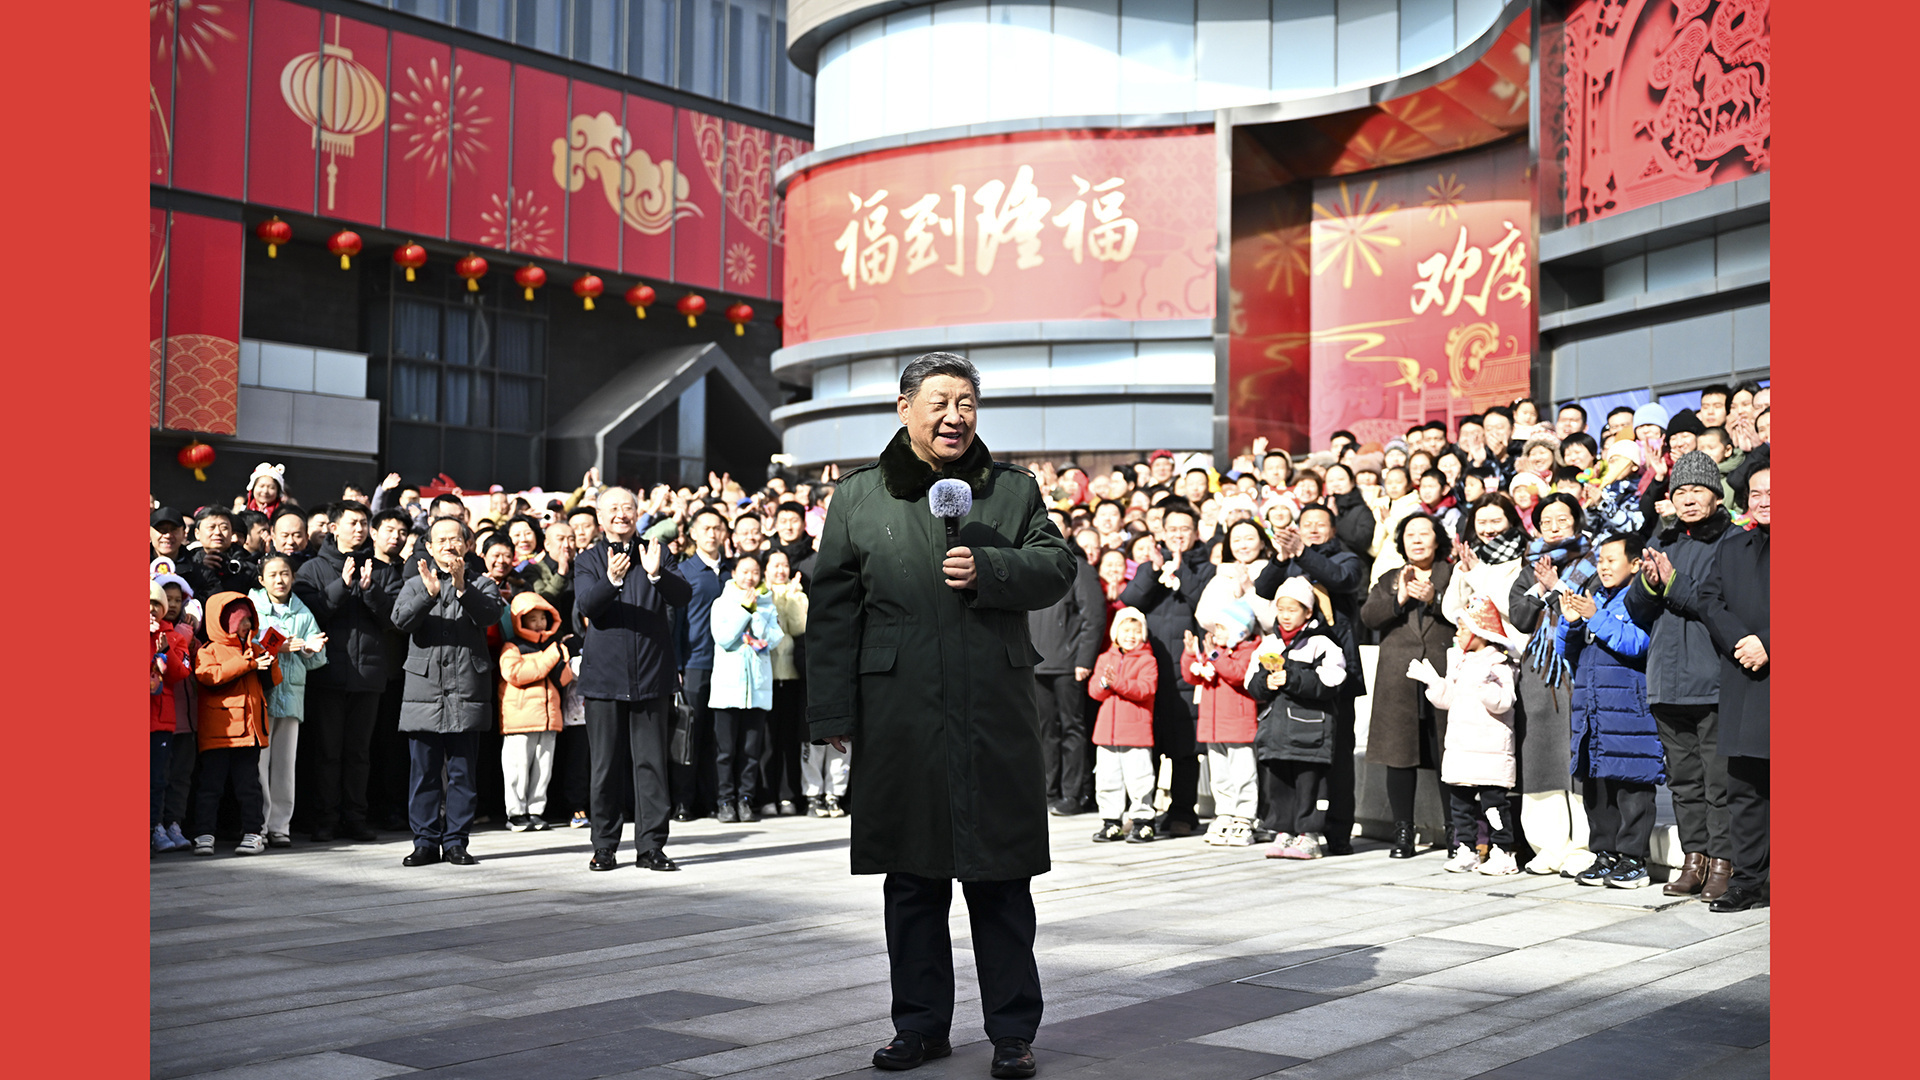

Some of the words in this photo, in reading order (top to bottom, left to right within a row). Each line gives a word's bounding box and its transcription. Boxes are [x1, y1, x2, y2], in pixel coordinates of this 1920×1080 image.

[834, 164, 1140, 291] 福到隆福
[1410, 220, 1531, 316] 欢度
